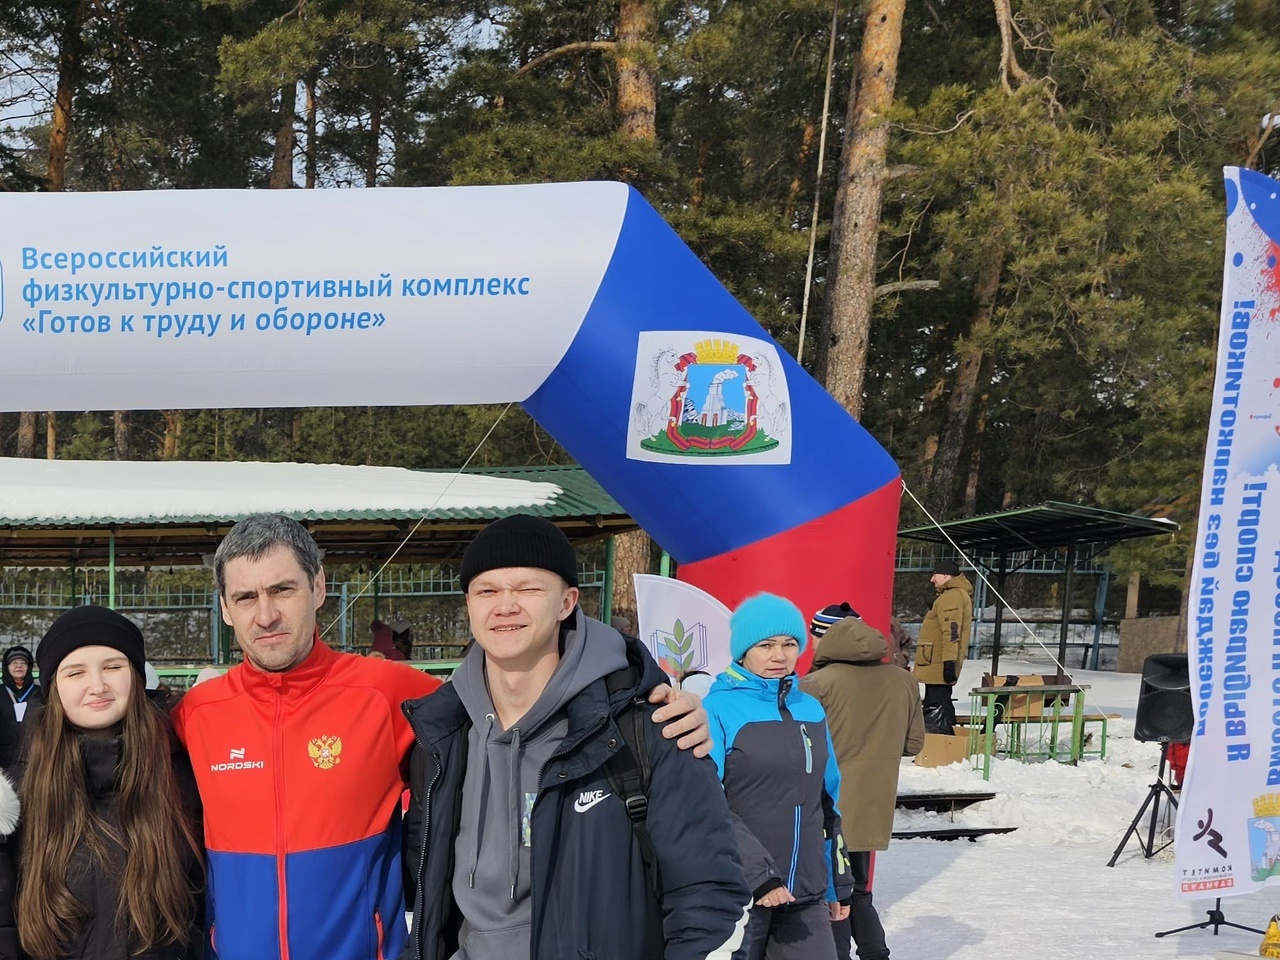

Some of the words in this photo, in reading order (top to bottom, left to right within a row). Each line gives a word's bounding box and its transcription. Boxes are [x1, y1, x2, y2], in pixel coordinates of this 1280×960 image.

[22, 245, 228, 275] Всероссийский
[22, 273, 393, 308] физкультурно-спортивный
[402, 276, 530, 297] комплекс
[22, 309, 111, 334] «Готов
[120, 315, 134, 332] к
[143, 313, 222, 338] труду
[230, 313, 246, 331] и
[255, 306, 386, 336] обороне»
[211, 761, 264, 772] NORDSKI
[579, 790, 603, 804] NIKE
